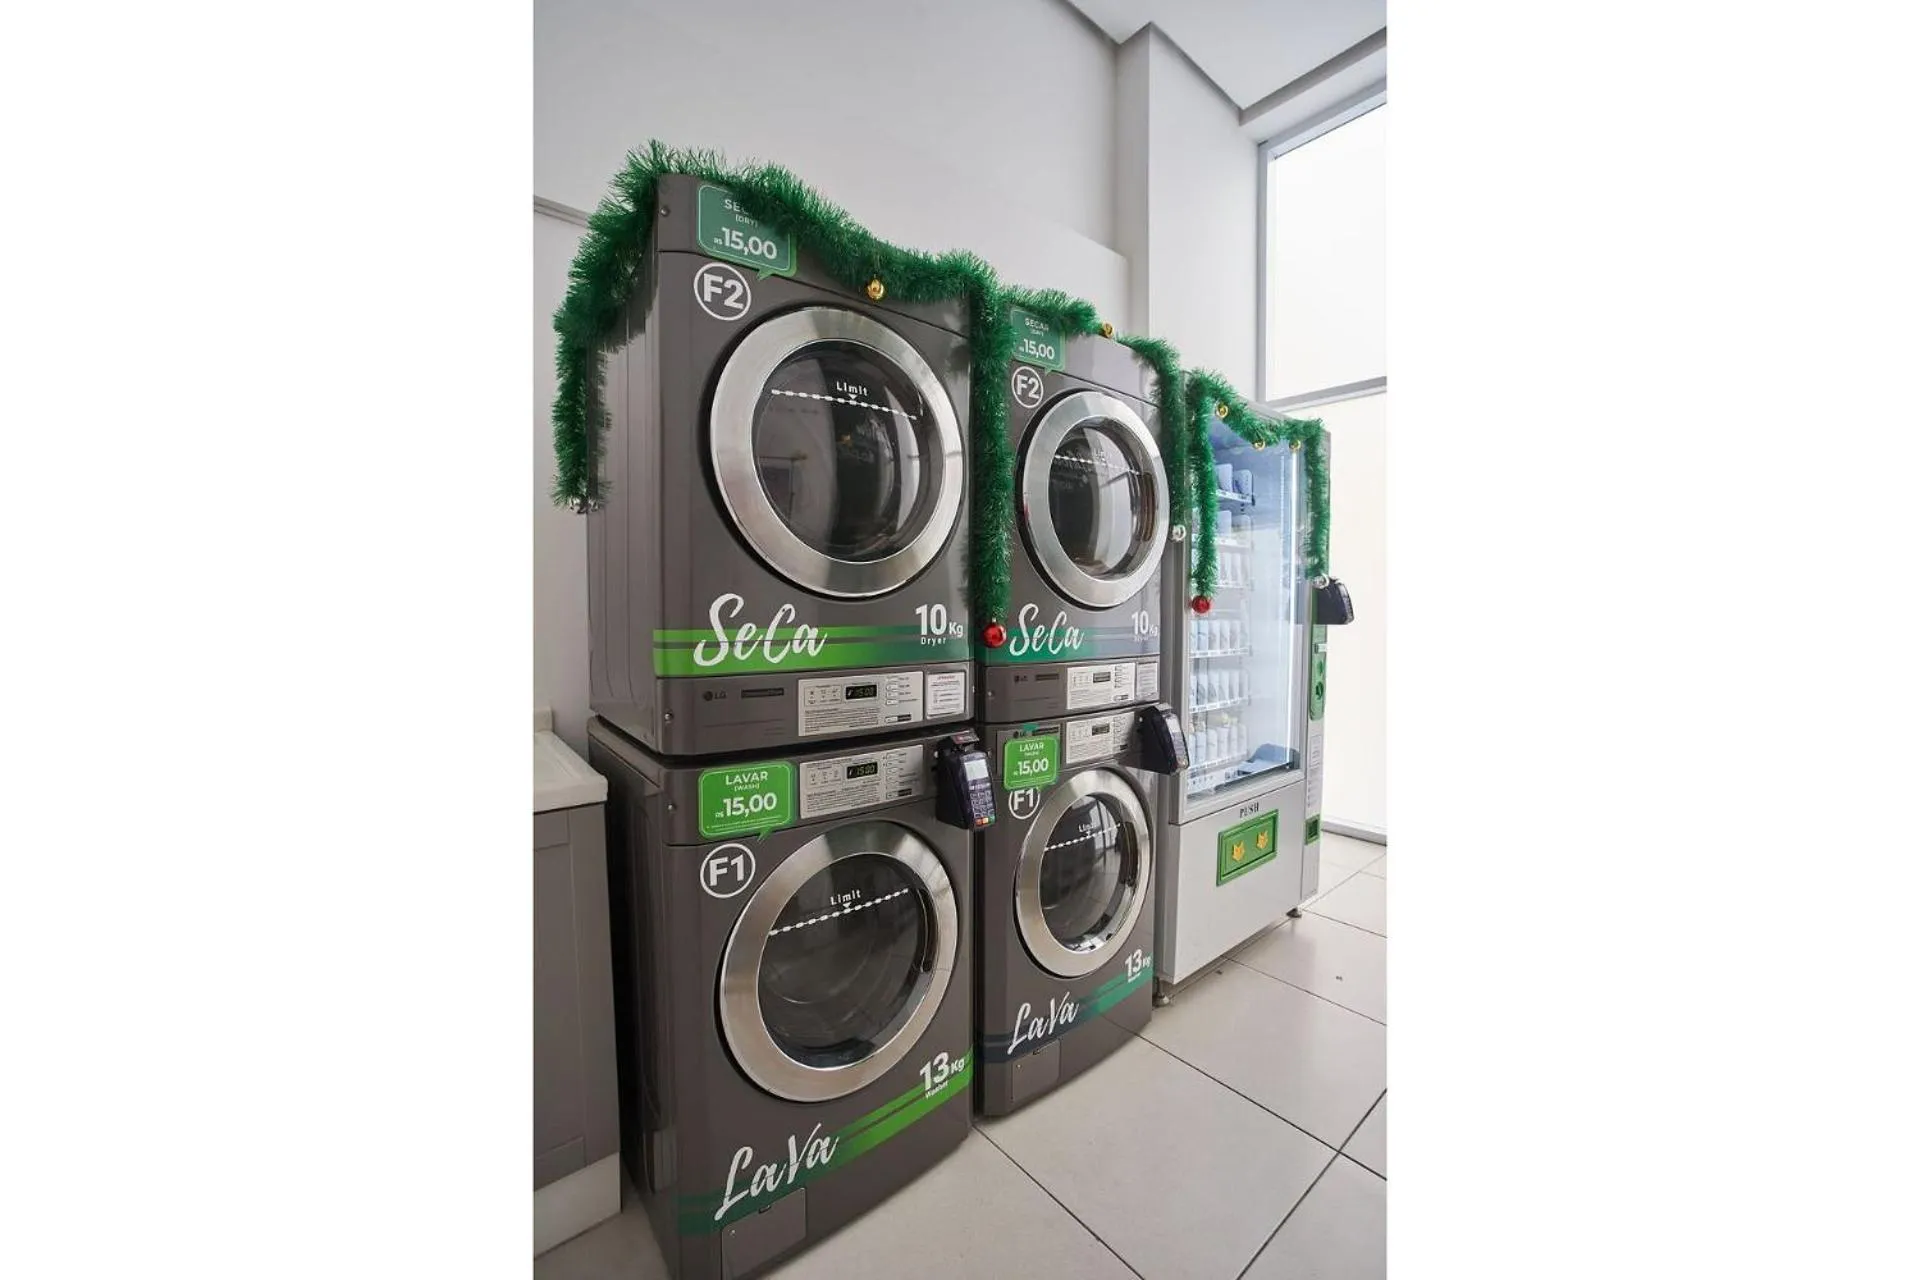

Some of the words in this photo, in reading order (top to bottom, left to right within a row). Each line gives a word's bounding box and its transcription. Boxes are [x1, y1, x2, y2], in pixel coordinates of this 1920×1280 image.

[721, 226, 778, 260] 15,00
[702, 273, 745, 311] F2
[1023, 338, 1055, 360] 15,00
[836, 380, 868, 396] Limit
[1015, 374, 1040, 400] F2
[915, 603, 947, 636] 10
[948, 621, 964, 638] Kg
[1131, 610, 1149, 635] 10
[920, 636, 947, 647] Dryer
[1019, 742, 1044, 753] LAVAR
[725, 771, 769, 786] LAVAR
[1018, 757, 1049, 777] 15,00
[723, 792, 778, 818] 15,00
[1013, 787, 1034, 811] F1
[1239, 801, 1260, 818] PUSH
[708, 854, 745, 887] F1
[830, 889, 861, 906] Limit
[1124, 948, 1143, 978] 13
[919, 1051, 949, 1091] 13
[950, 1058, 965, 1074] Kg
